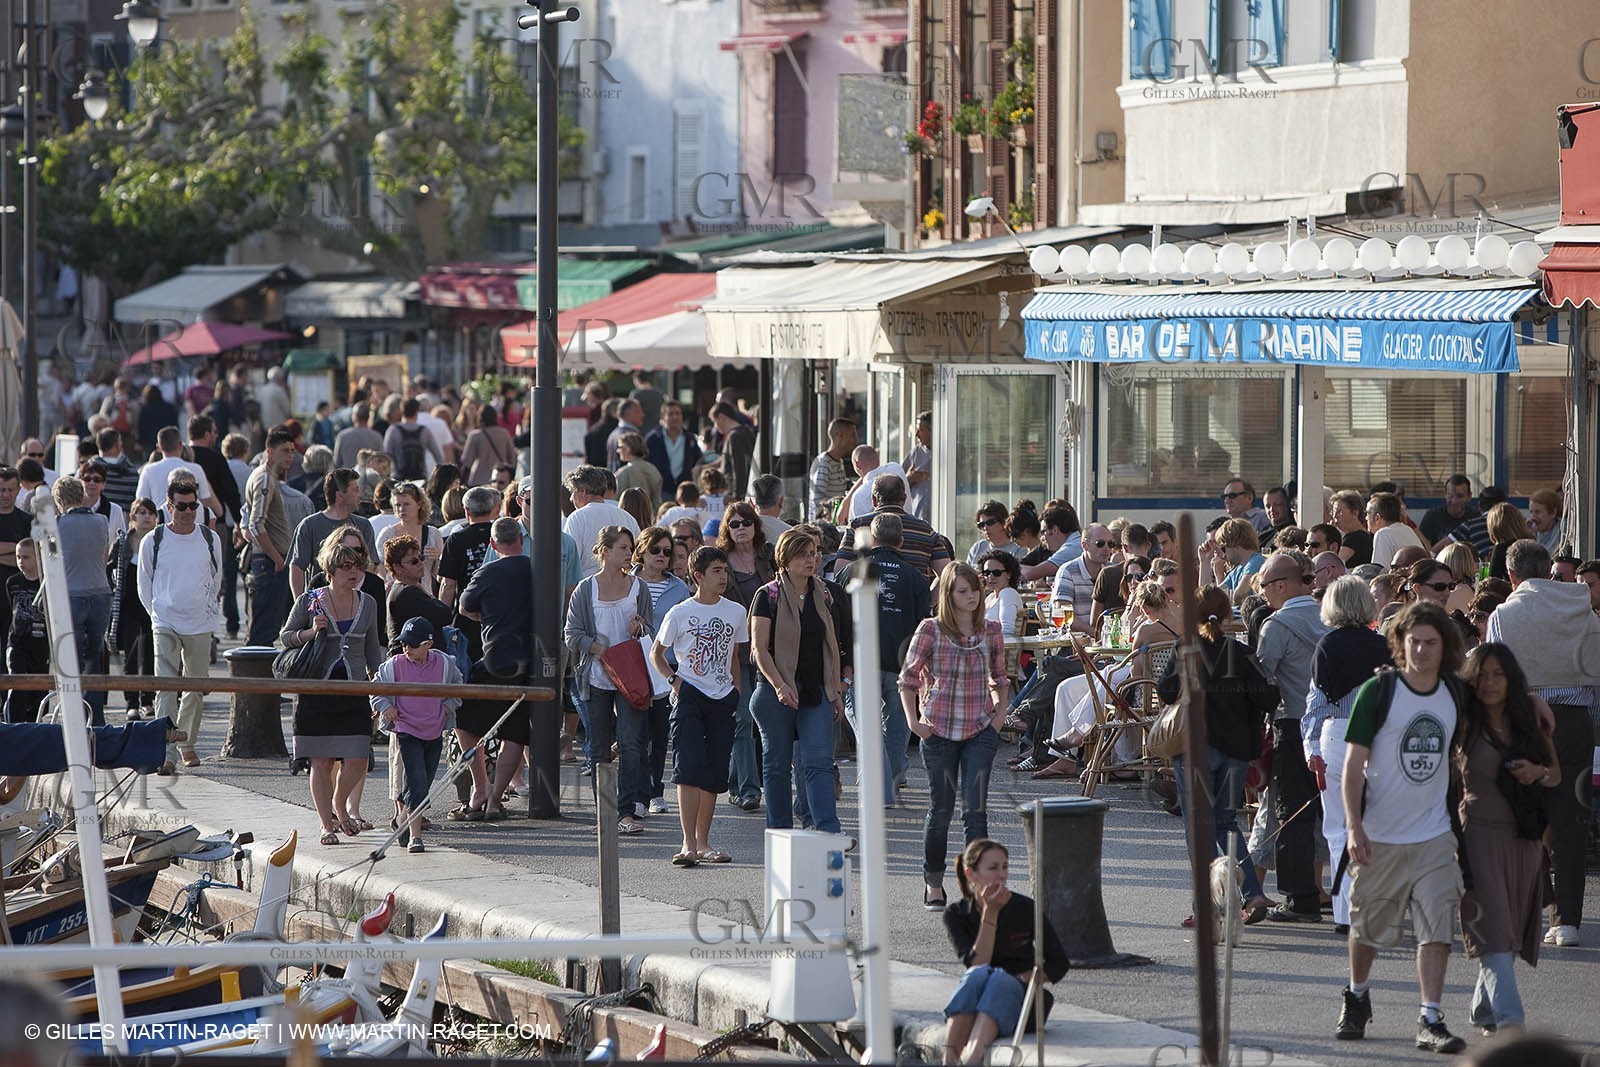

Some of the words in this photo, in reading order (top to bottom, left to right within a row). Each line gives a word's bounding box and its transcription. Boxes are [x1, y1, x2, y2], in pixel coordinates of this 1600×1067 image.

[1105, 325, 1145, 358] BAR
[1158, 323, 1191, 357] DE
[1208, 323, 1240, 358] LA
[1260, 323, 1363, 362] MARINE
[1429, 333, 1484, 363] COCKTAILS
[24, 924, 48, 946] MT
